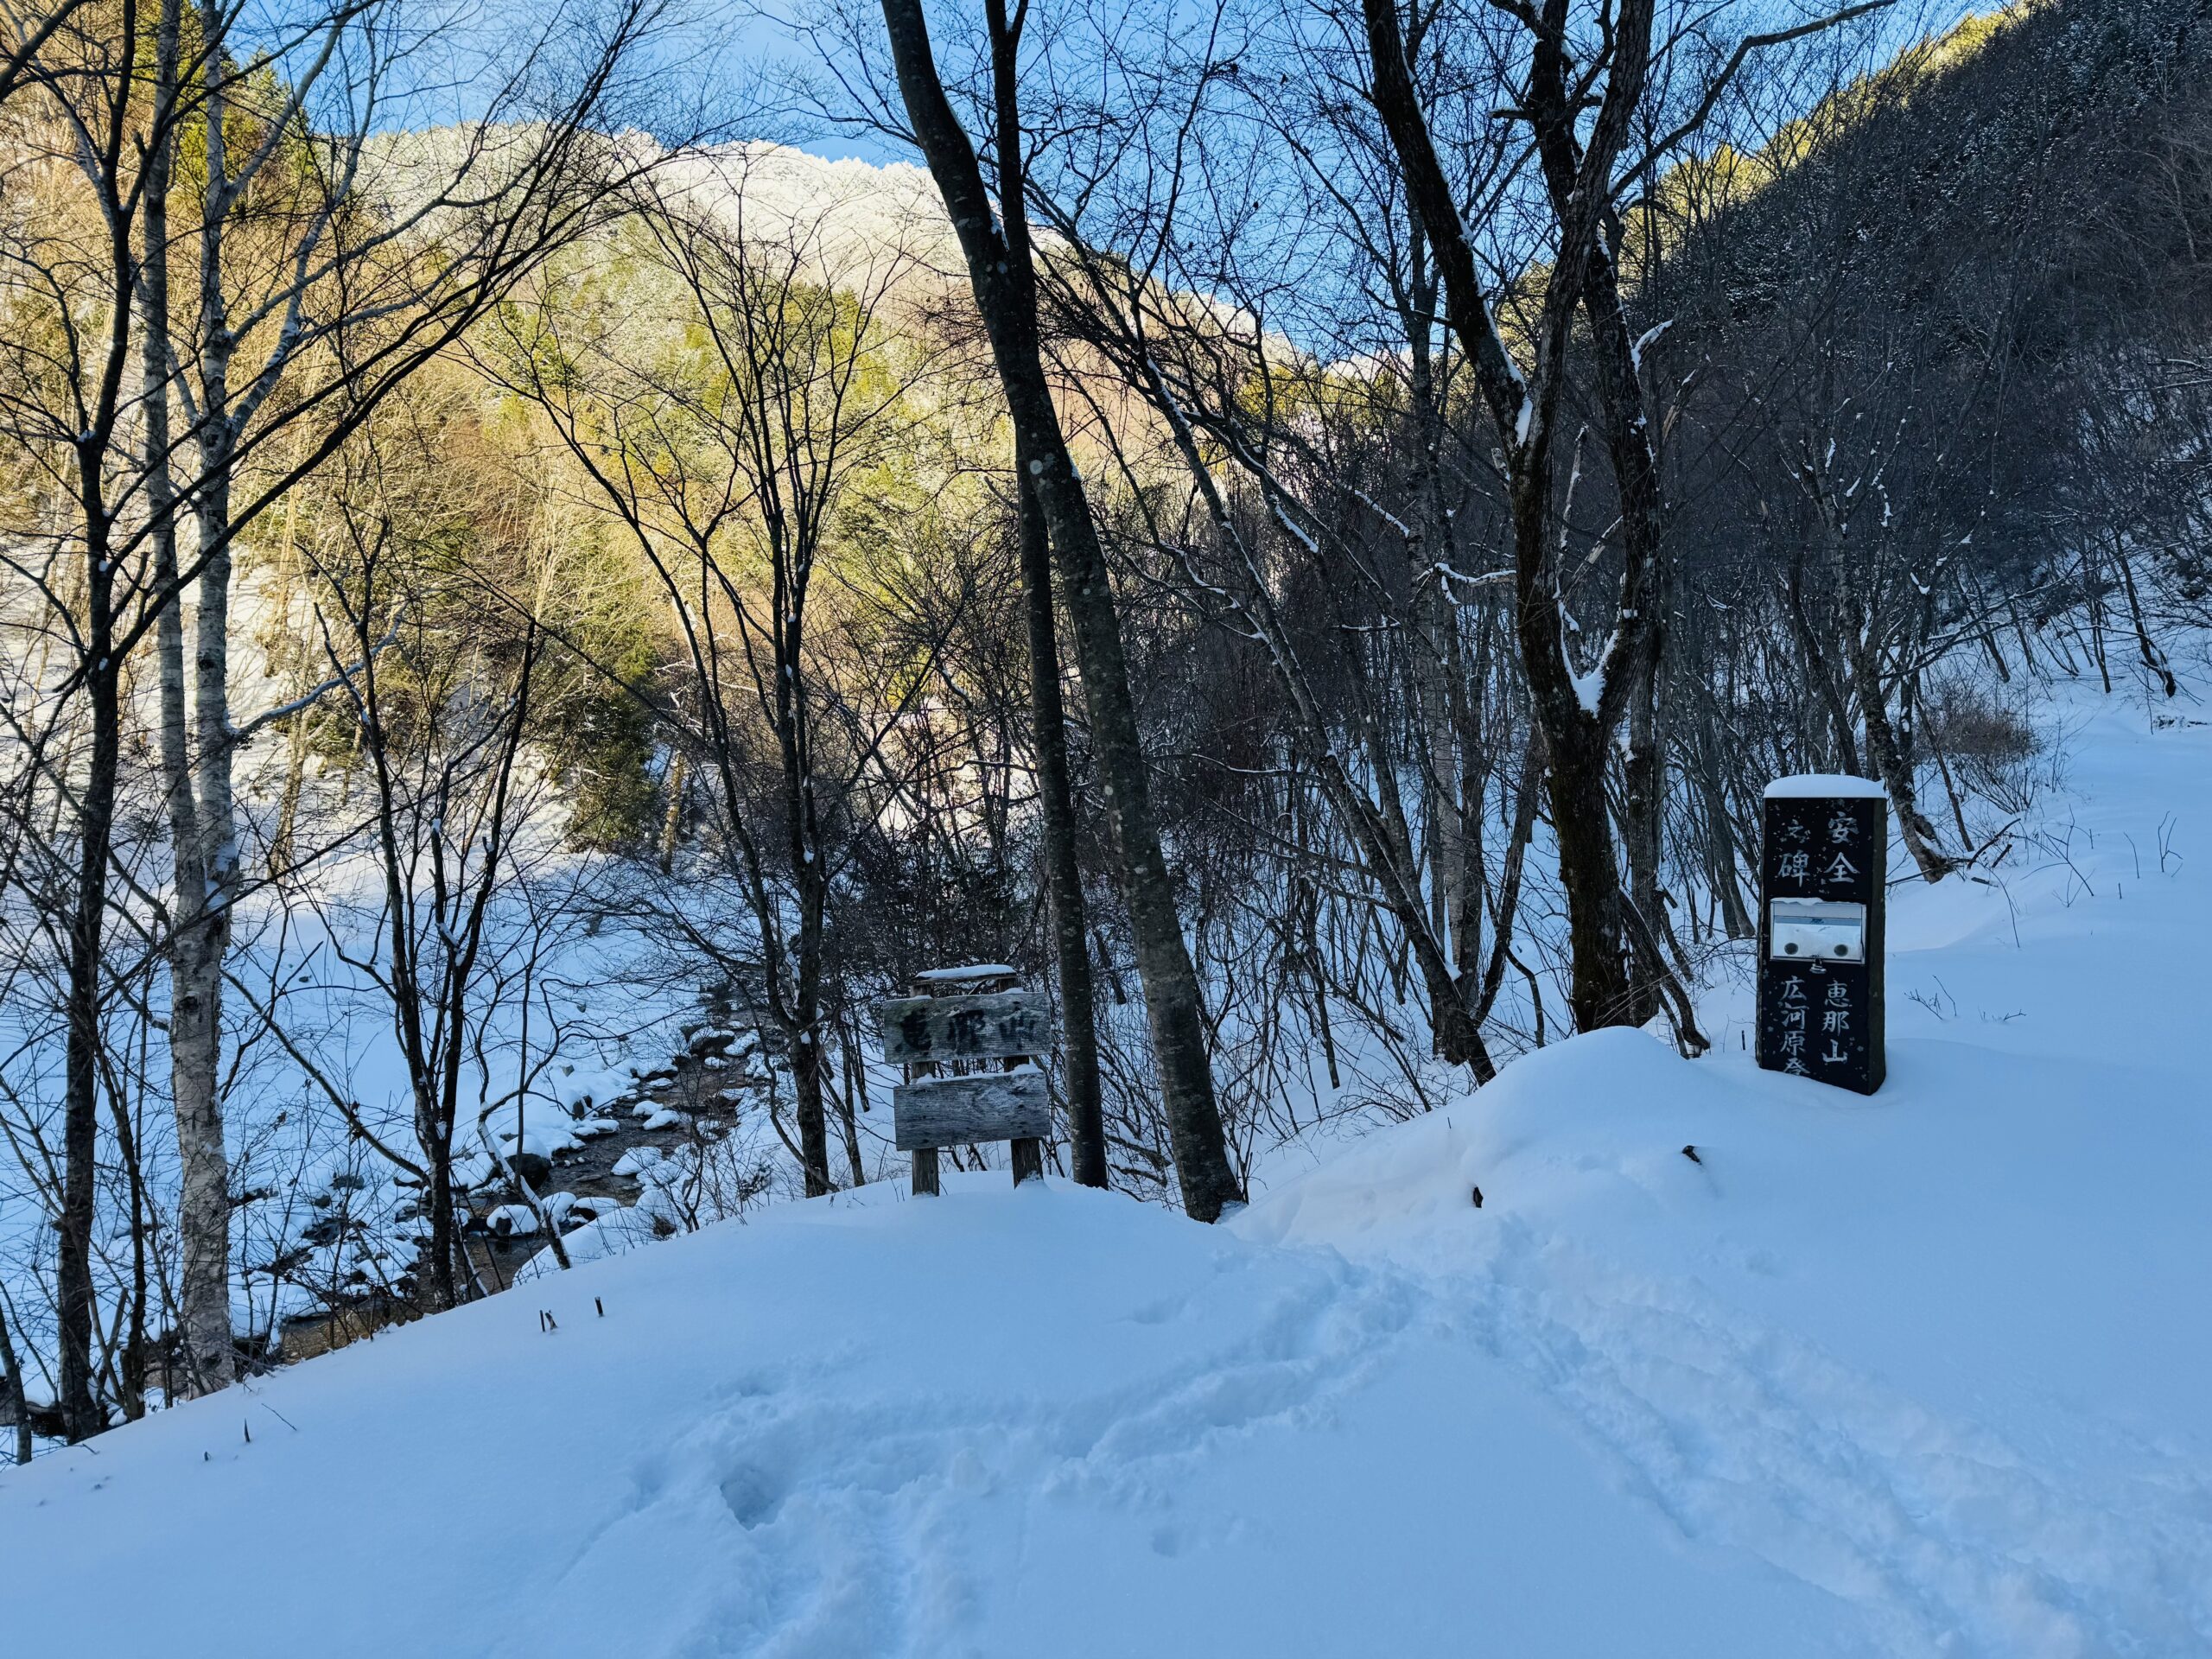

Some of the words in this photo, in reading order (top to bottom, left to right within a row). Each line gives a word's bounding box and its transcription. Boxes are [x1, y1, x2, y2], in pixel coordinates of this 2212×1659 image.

[1777, 818, 1811, 888] 之碑
[1823, 810, 1861, 883] 安全
[1821, 978, 1852, 1063] 恵那山
